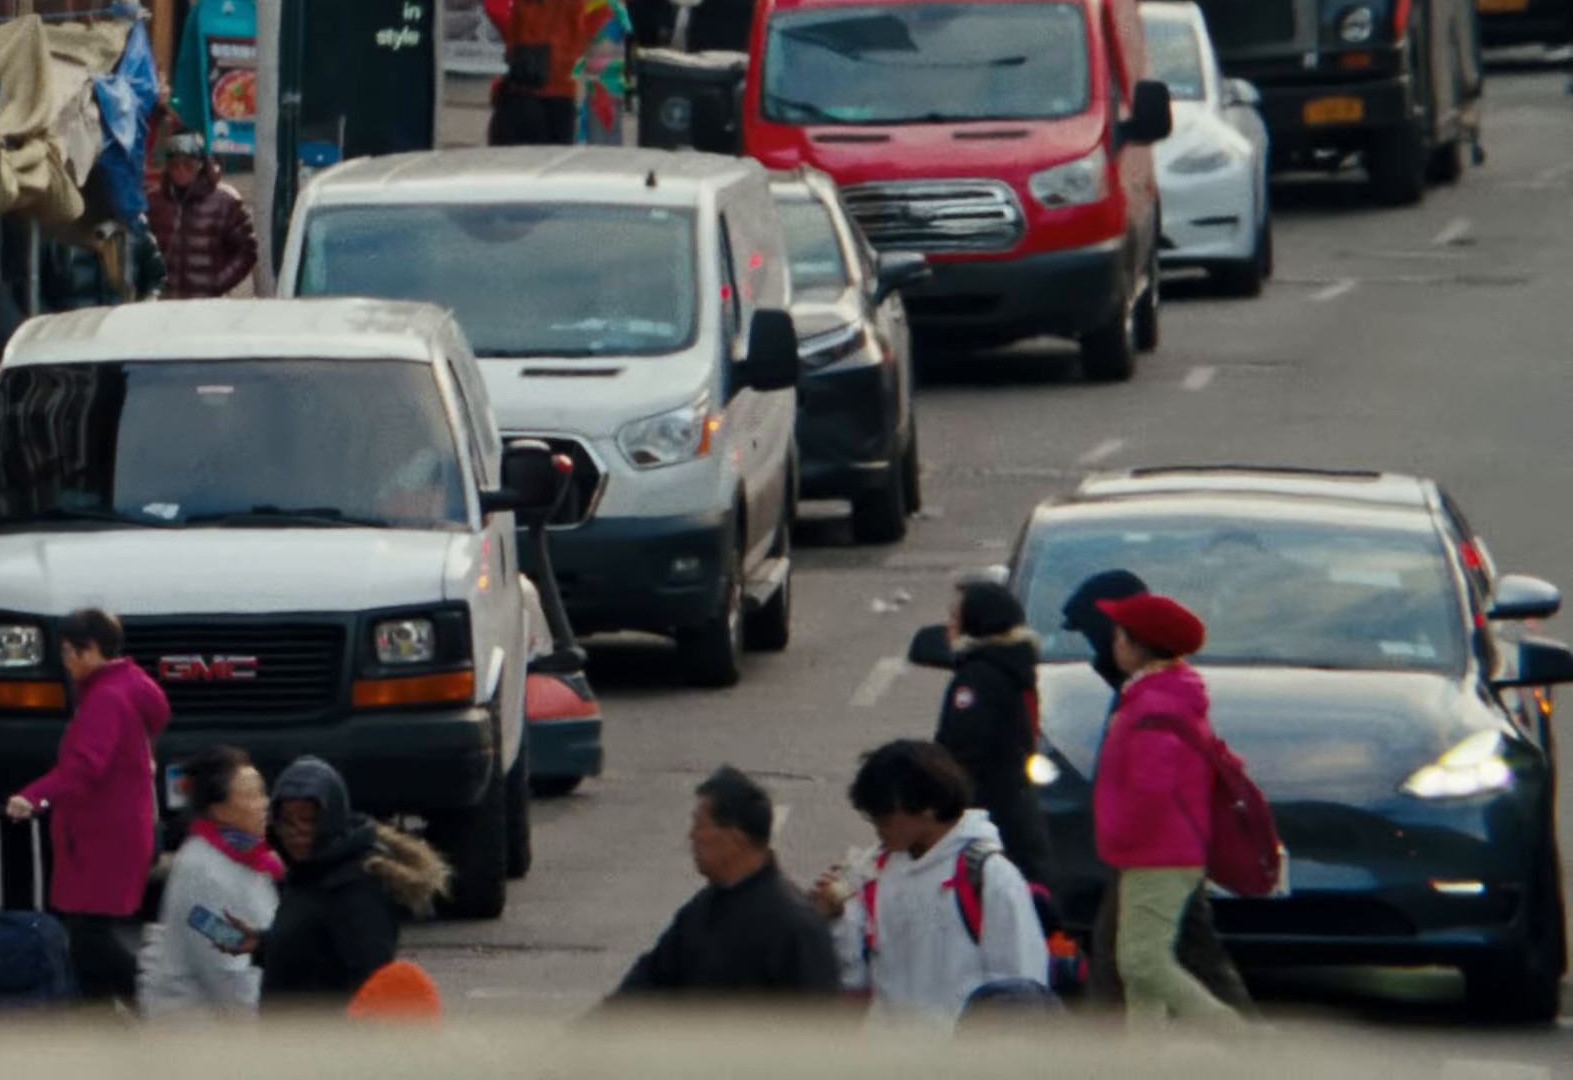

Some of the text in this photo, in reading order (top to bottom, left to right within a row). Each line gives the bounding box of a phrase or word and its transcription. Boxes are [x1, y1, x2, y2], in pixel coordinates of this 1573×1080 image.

[403, 2, 422, 21] in
[375, 27, 421, 52] style
[158, 654, 259, 680] GMC
